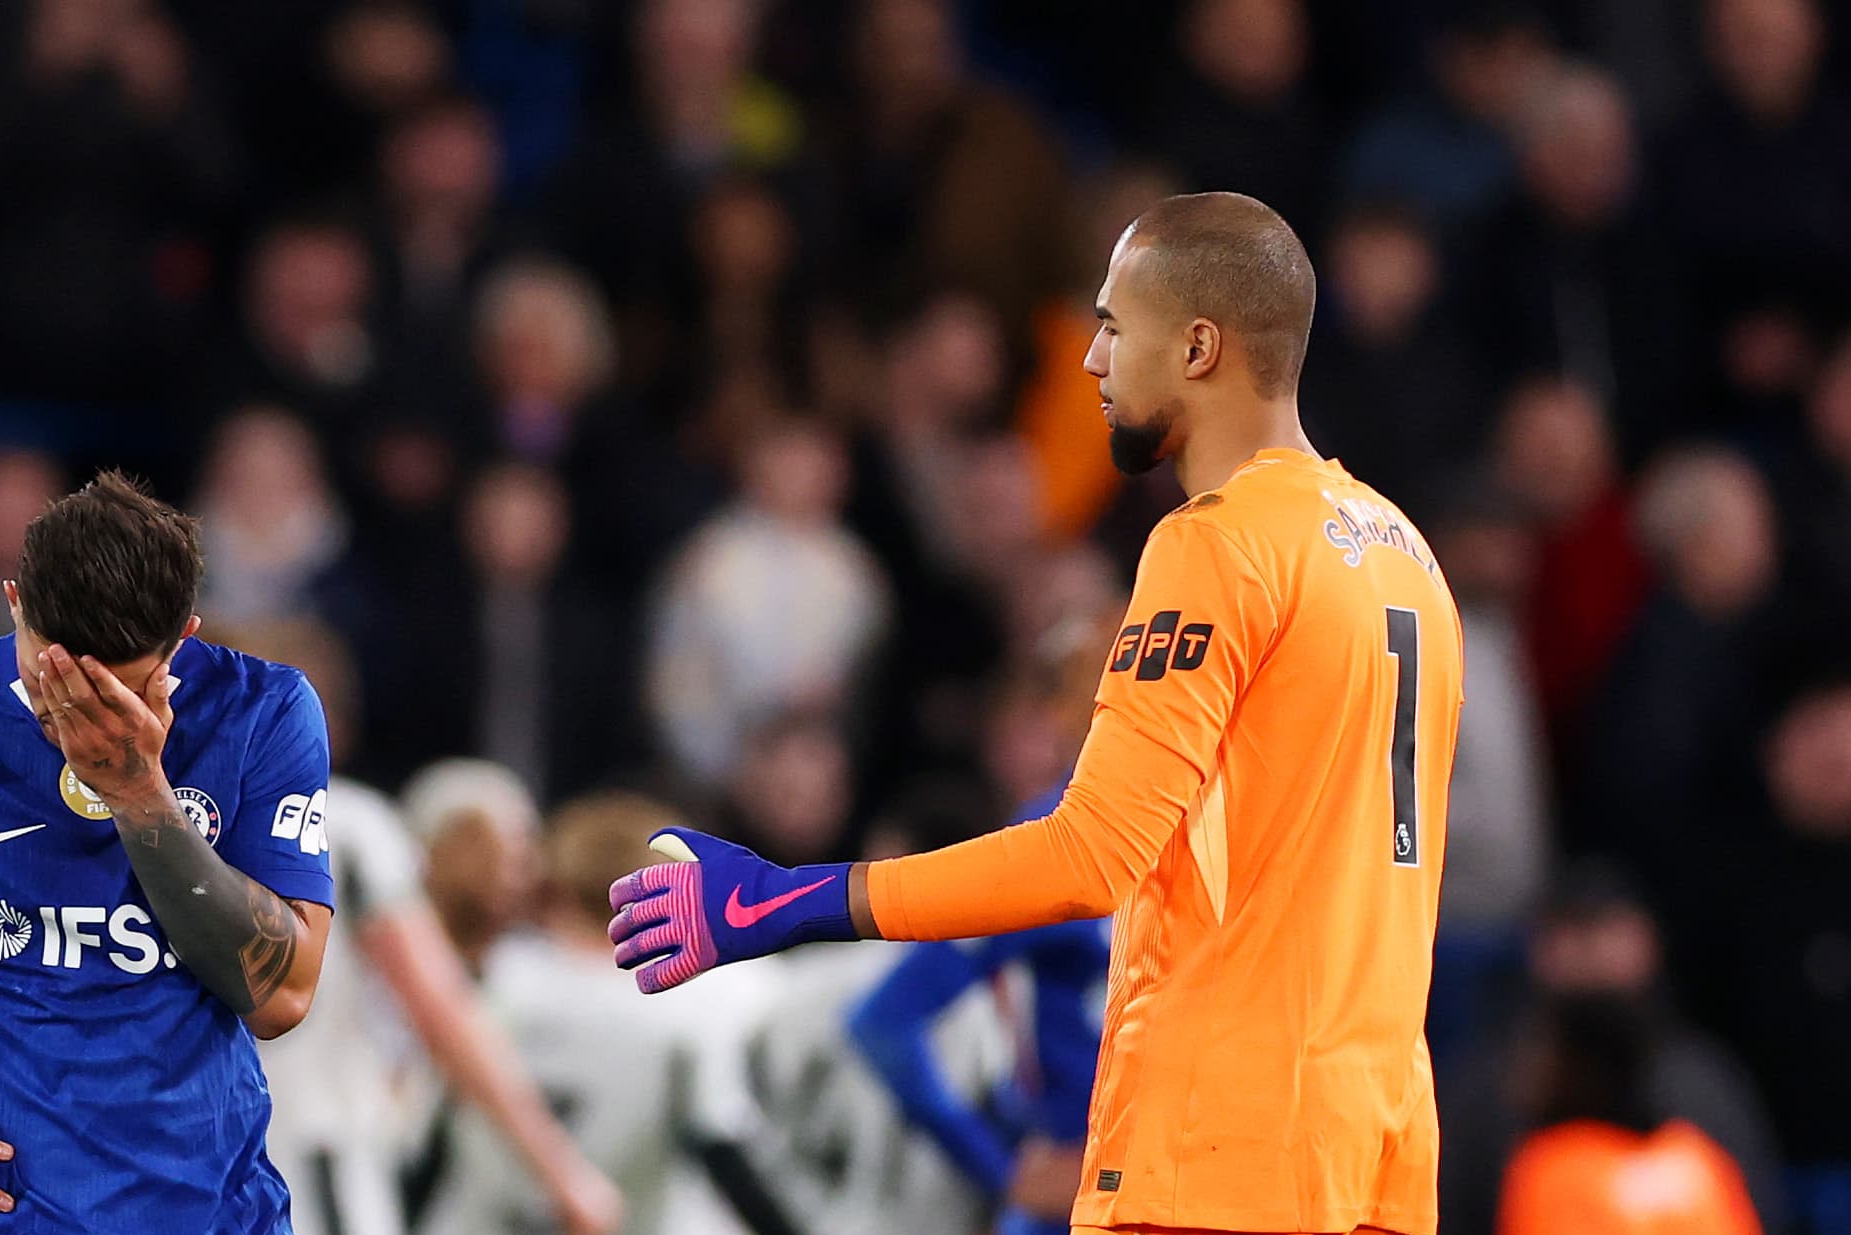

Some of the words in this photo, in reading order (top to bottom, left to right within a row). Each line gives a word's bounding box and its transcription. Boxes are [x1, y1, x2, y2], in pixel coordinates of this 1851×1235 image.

[1385, 606, 1419, 867] 1
[175, 790, 208, 807] ELSEA
[39, 904, 177, 974] IFS.
